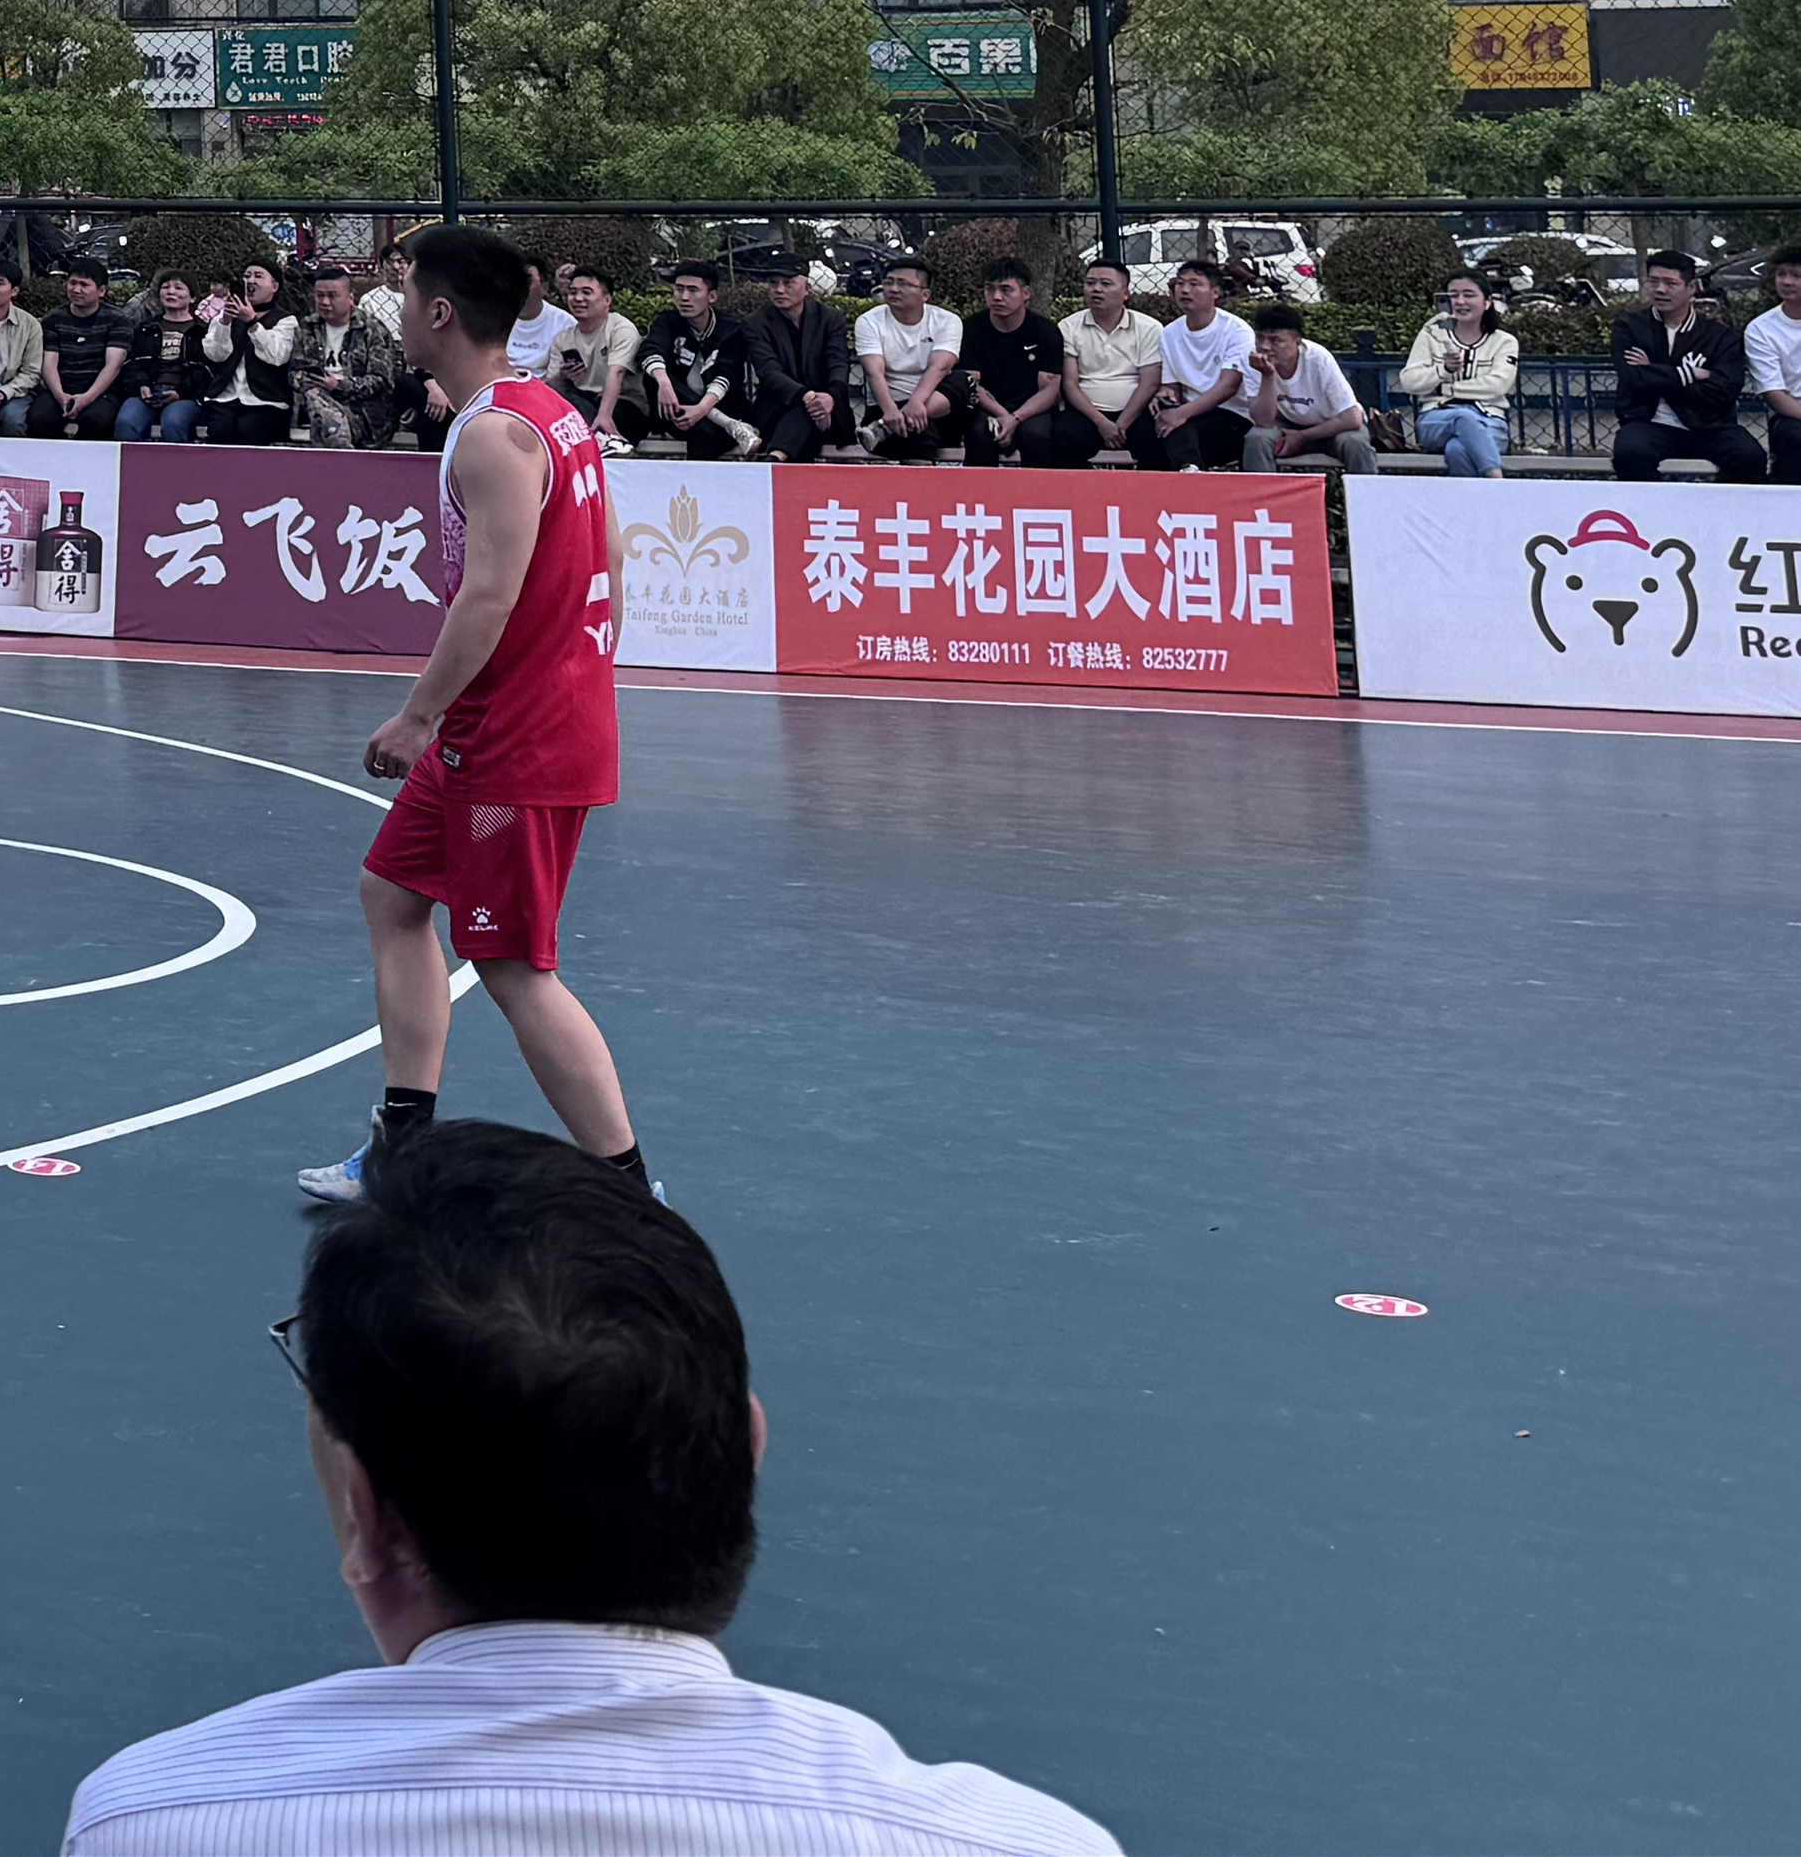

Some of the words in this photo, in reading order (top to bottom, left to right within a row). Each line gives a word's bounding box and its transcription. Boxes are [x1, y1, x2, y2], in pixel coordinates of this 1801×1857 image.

[926, 38, 1037, 75] 百果
[144, 497, 441, 606] 云飞饭
[802, 498, 1295, 626] 泰丰花园大酒店
[1740, 625, 1801, 658] Re
